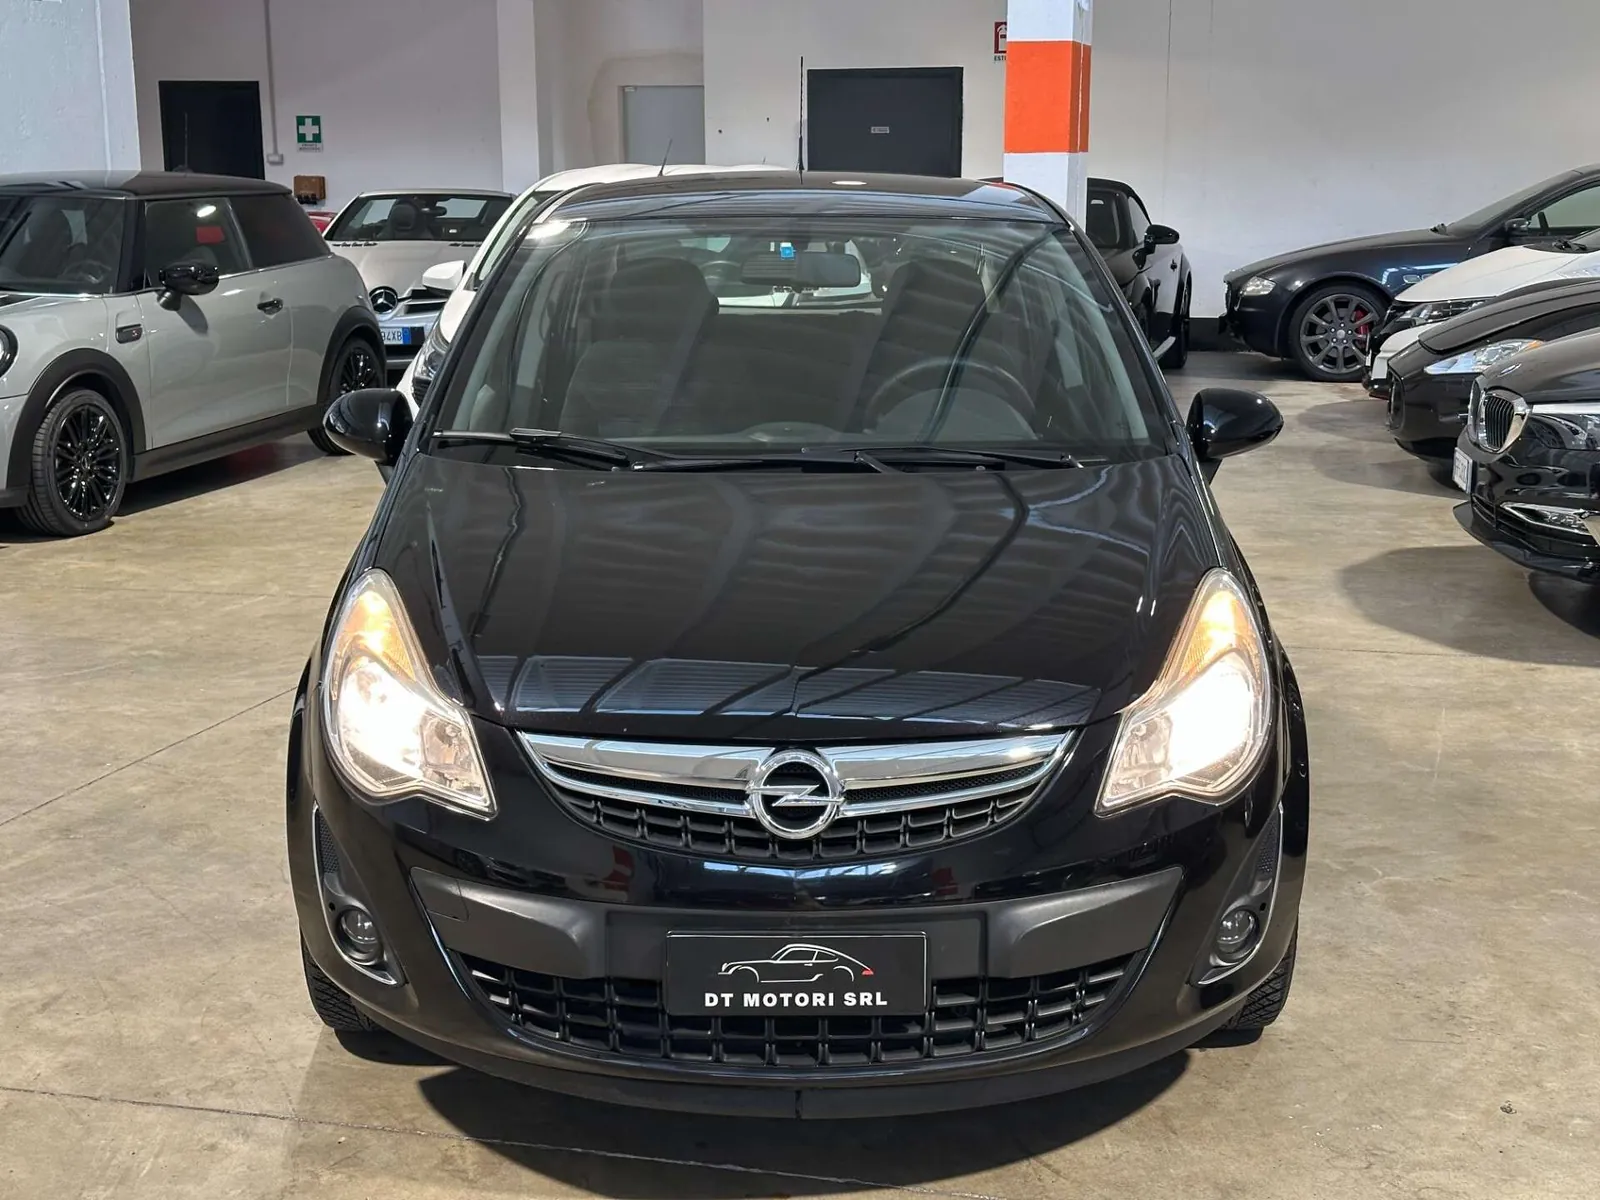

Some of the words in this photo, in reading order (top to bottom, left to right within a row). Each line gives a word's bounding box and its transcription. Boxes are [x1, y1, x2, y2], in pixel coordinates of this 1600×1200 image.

[704, 993, 733, 1007] DT
[743, 992, 834, 1007] MOTORI
[843, 991, 888, 1006] SRL
